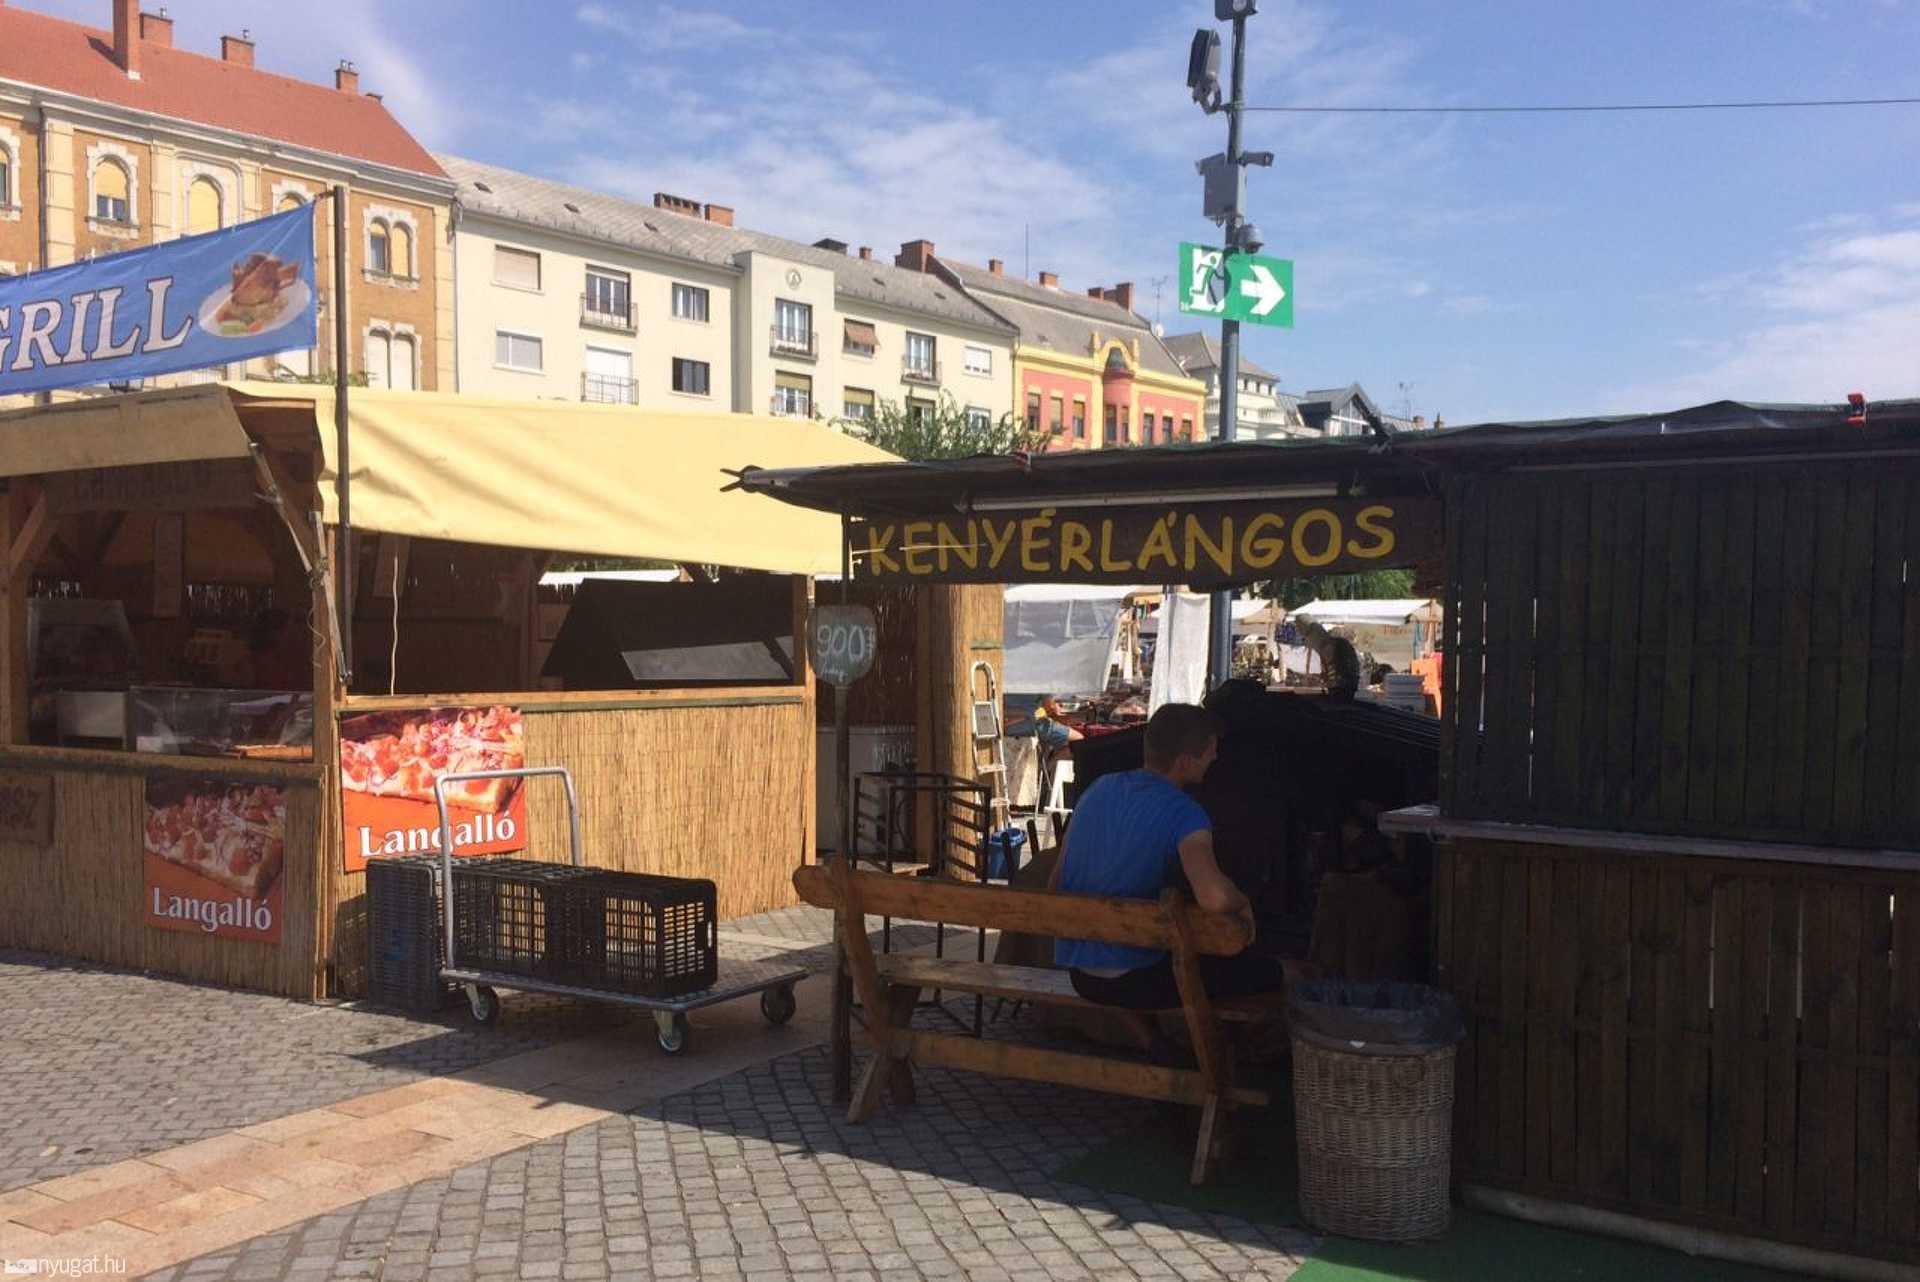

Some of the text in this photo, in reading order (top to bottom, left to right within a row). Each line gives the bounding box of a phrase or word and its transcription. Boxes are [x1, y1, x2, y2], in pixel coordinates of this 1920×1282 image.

[0, 275, 193, 373] RILL
[868, 505, 1396, 577] KENYÉRLÁNGOS
[153, 887, 271, 932] Langalló
